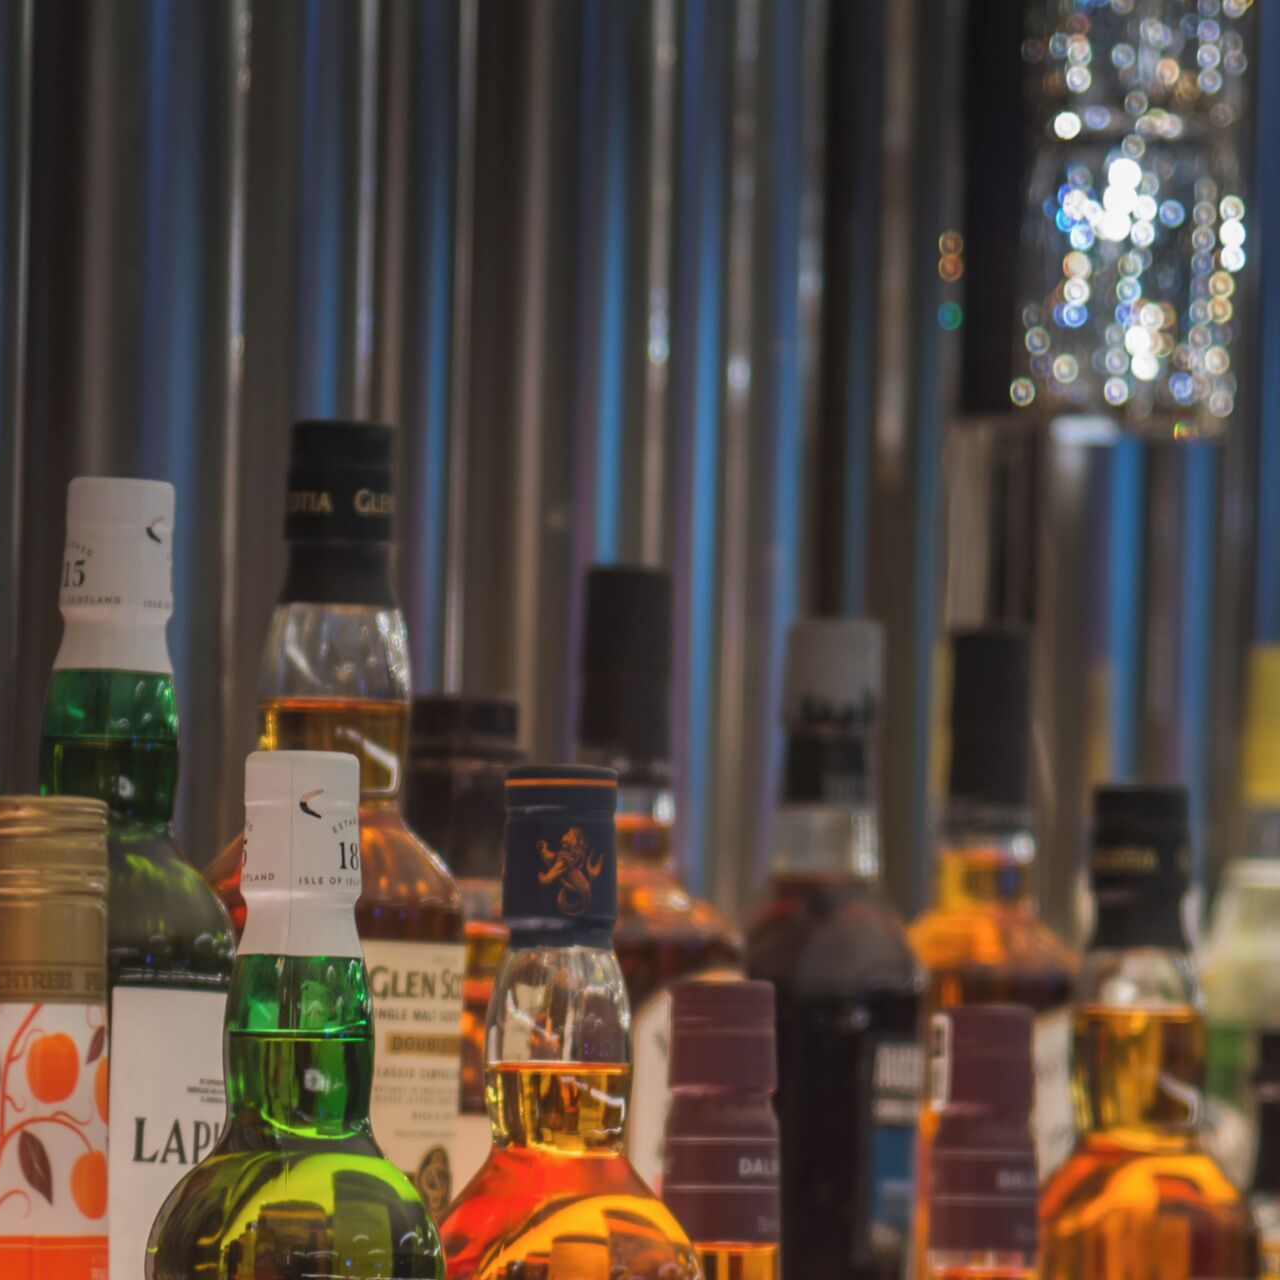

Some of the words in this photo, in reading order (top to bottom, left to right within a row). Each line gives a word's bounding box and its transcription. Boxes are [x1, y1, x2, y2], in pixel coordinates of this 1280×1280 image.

[332, 817, 357, 834] ESTA
[299, 876, 324, 885] ISLE
[330, 877, 342, 885] OF
[370, 965, 436, 1001] GLEN
[375, 1007, 408, 1021] NGLE
